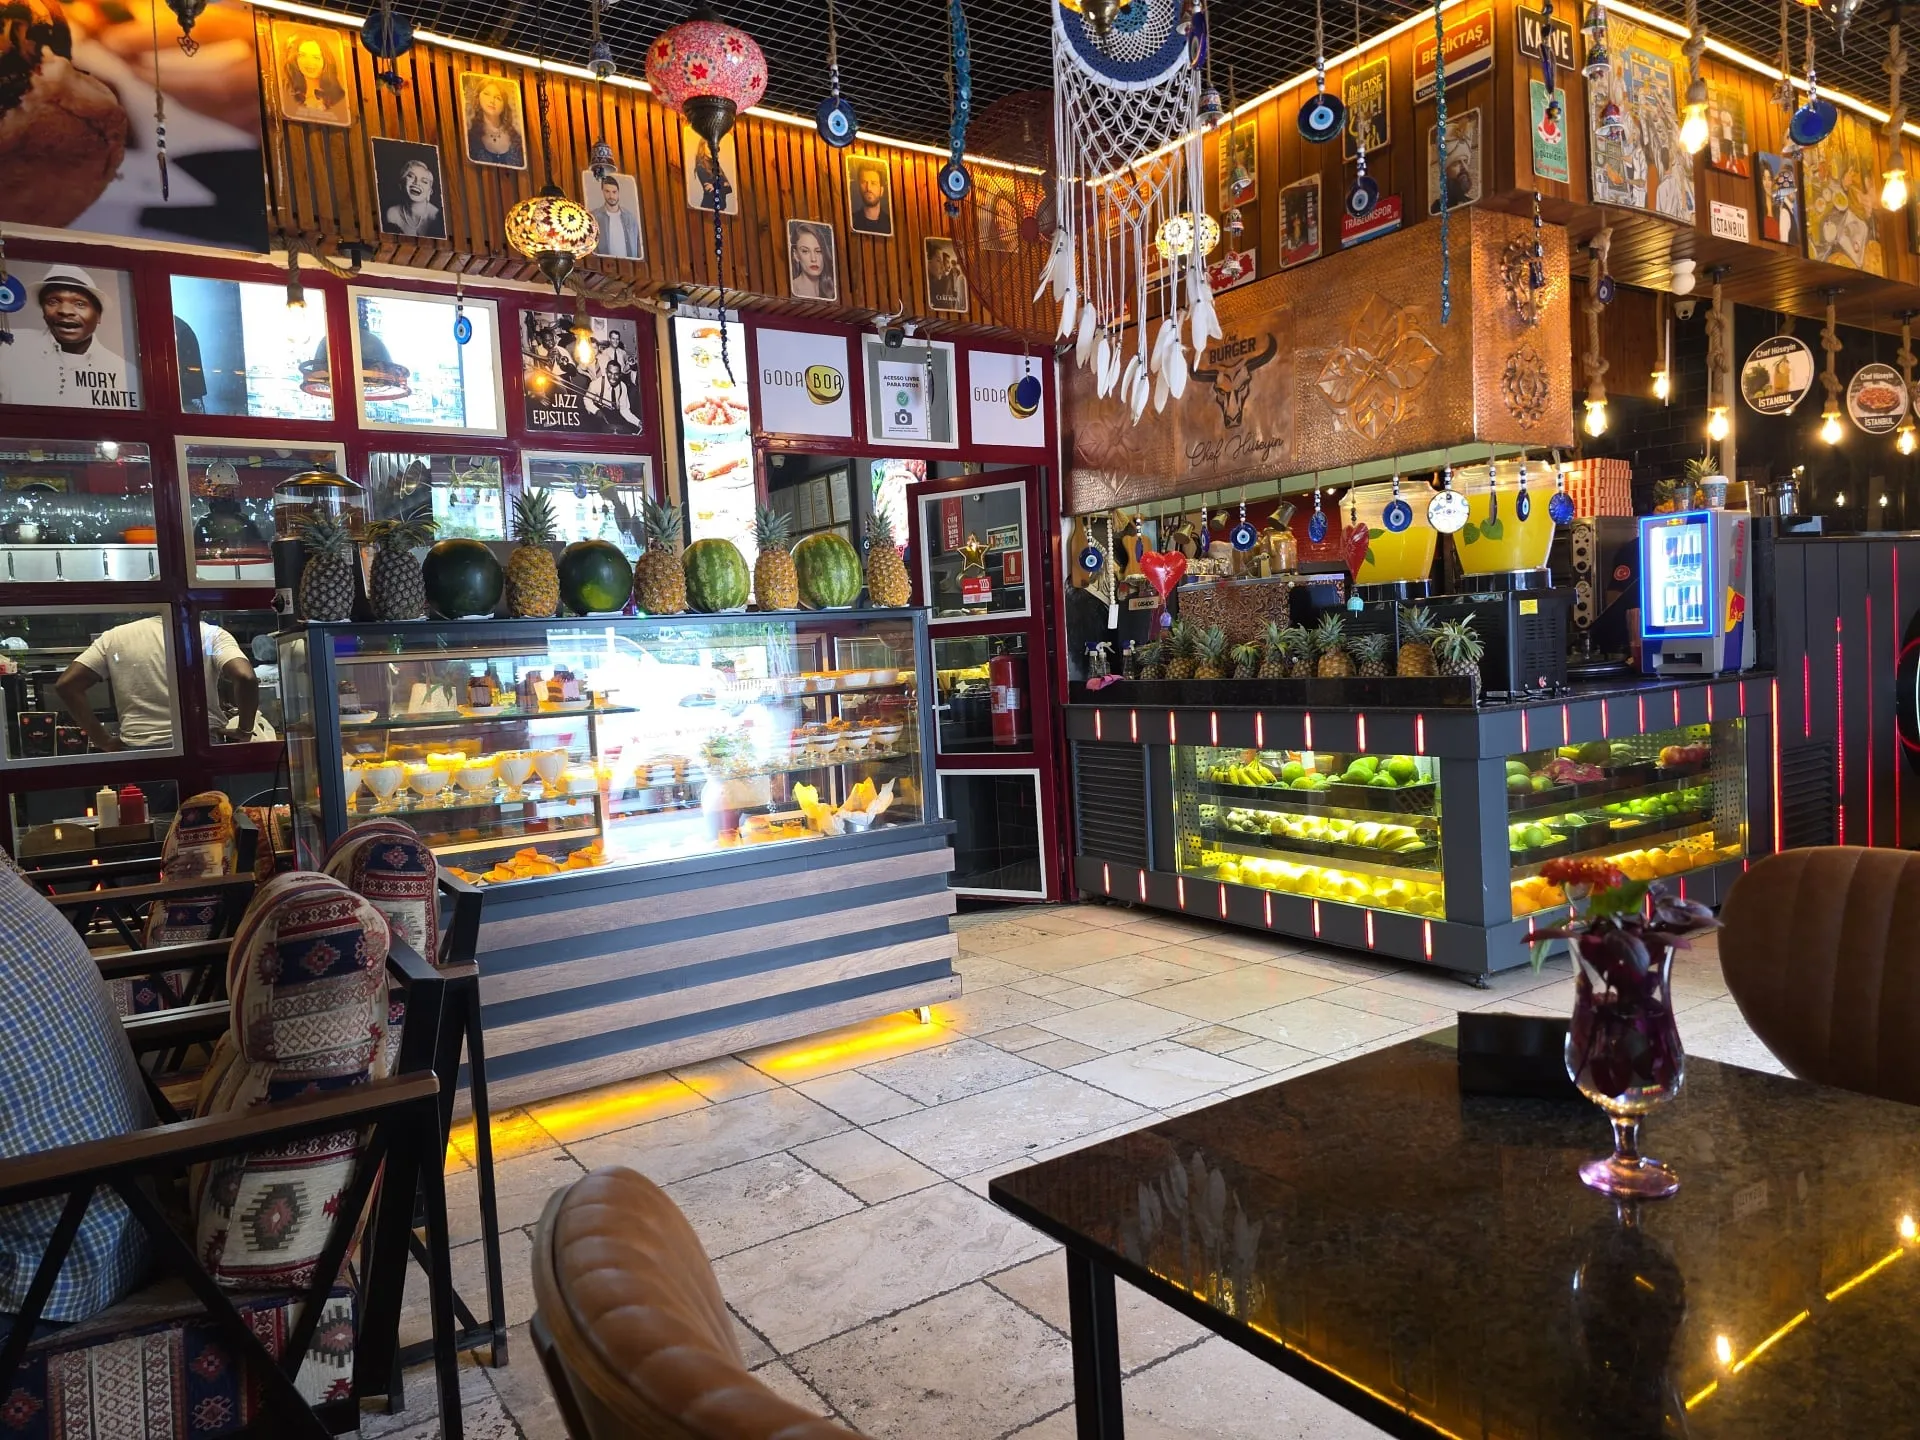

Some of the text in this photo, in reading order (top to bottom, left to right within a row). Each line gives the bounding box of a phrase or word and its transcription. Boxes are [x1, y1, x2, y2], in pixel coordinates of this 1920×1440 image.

[1713, 214, 1746, 238] İSTANBUL
[1209, 337, 1256, 364] BURGER
[75, 370, 117, 389] MORY
[763, 369, 842, 390] GODA BOA
[91, 389, 138, 408] KANTE
[552, 393, 578, 409] JAZZ
[974, 387, 1006, 403] GODA
[1758, 394, 1794, 408] İSTANBUL
[533, 410, 580, 427] EPISTLES
[1864, 417, 1895, 427] İSTANBUL
[1186, 438, 1224, 472] Chef
